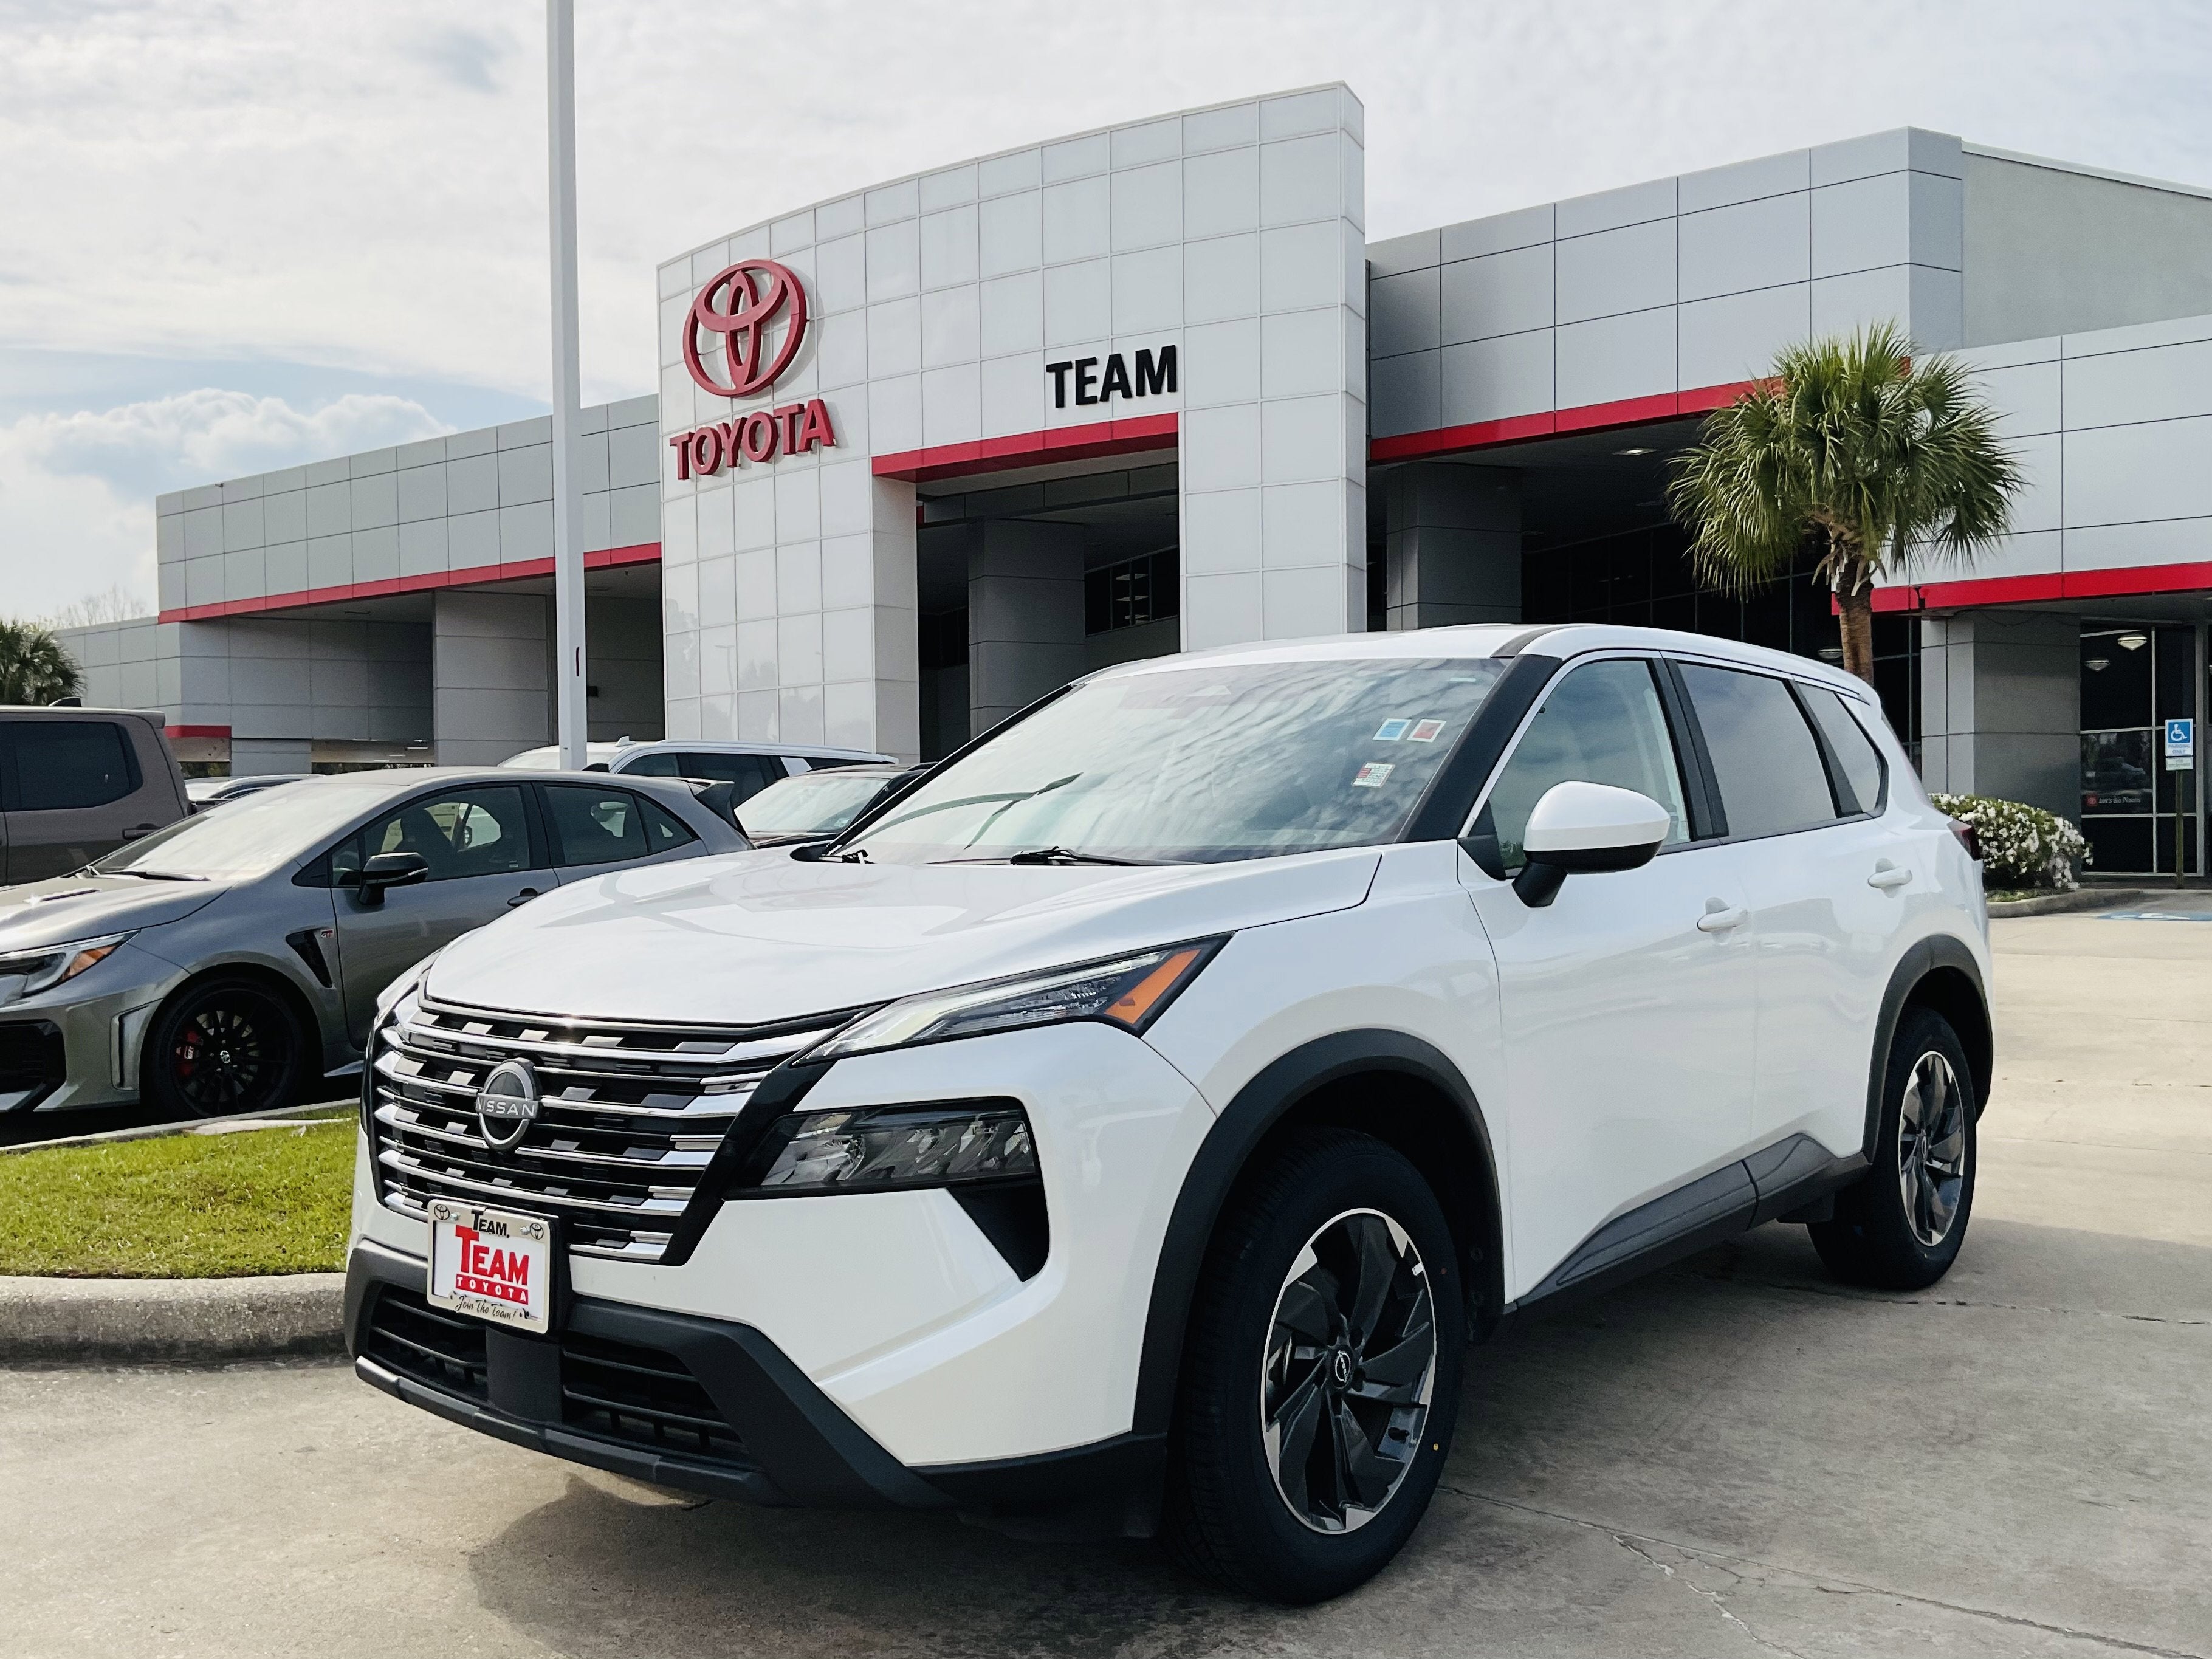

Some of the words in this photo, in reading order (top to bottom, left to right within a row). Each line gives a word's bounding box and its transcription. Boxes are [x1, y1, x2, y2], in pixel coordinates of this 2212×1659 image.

[1046, 345, 1177, 408] TEAM
[670, 399, 837, 480] TOYOTA
[476, 1097, 535, 1116] NISSAN
[456, 1224, 529, 1286] TEAM
[455, 1294, 474, 1311] Join
[475, 1299, 489, 1314] The
[456, 1276, 527, 1302] TOYOTA
